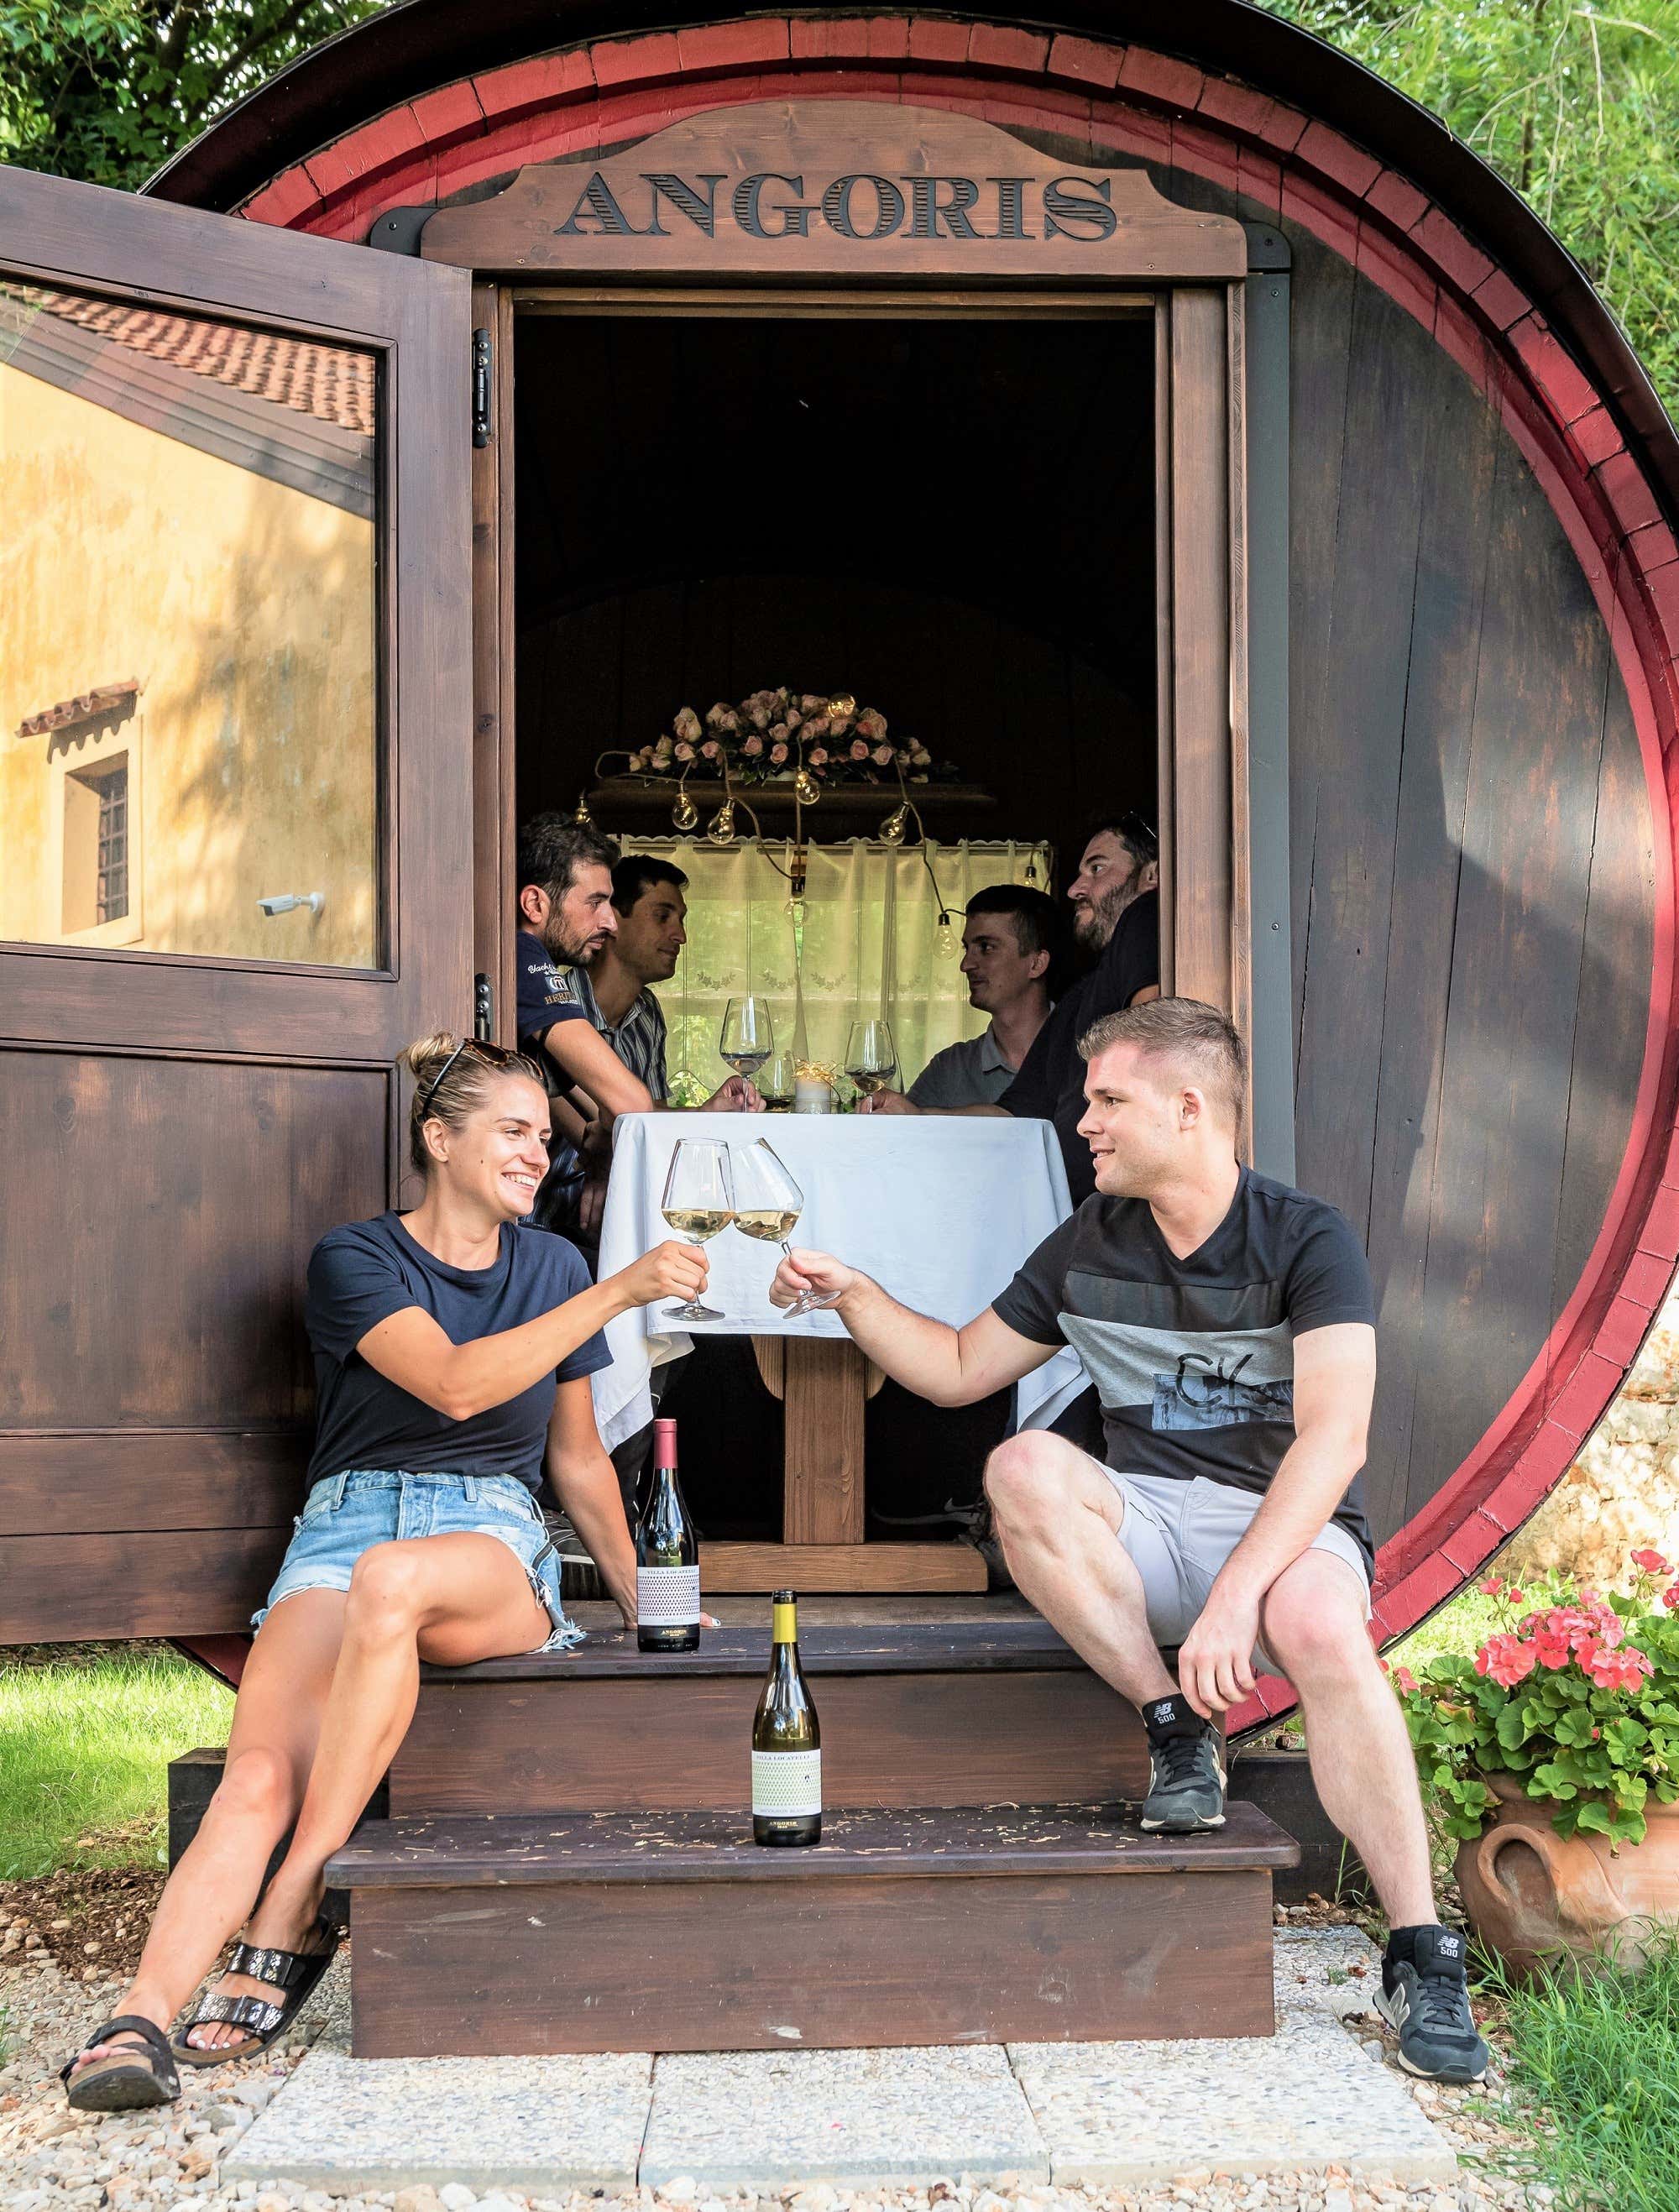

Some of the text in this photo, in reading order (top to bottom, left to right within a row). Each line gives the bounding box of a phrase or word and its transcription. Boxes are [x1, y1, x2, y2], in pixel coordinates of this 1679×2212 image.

[553, 170, 1117, 242] ANGORIS
[1158, 1713, 1175, 1723] 500
[1441, 1948, 1457, 1958] 500
